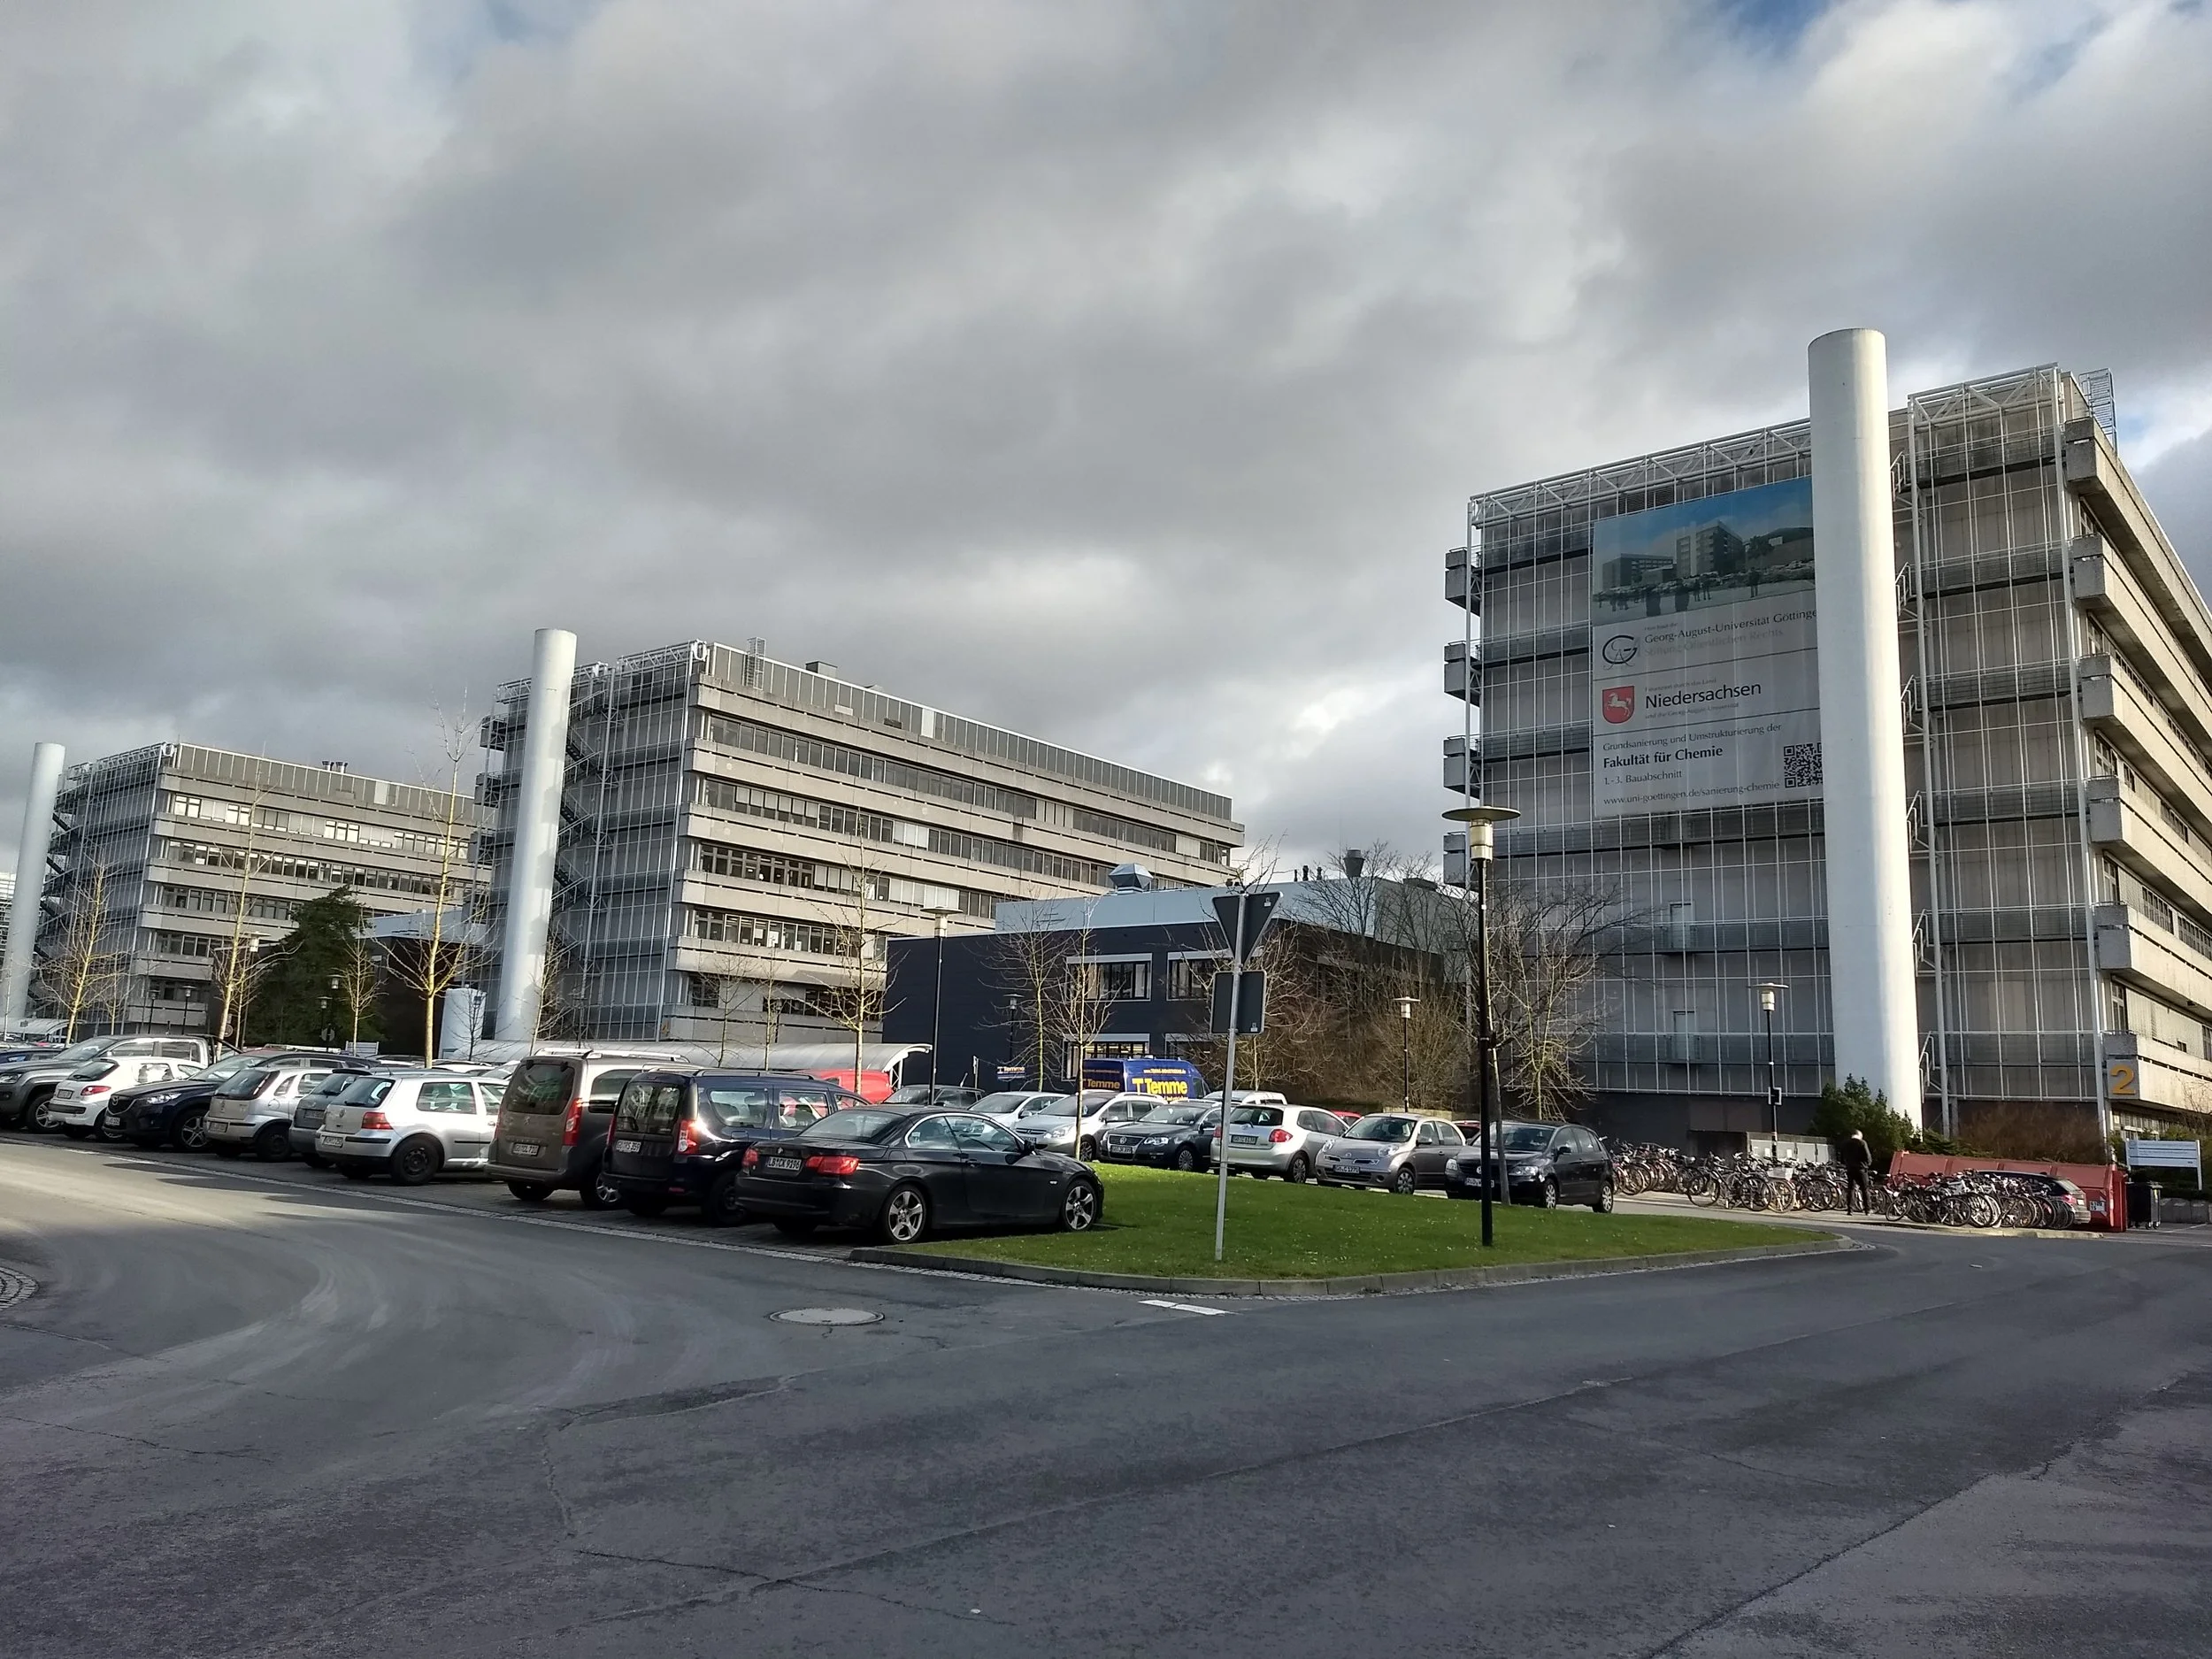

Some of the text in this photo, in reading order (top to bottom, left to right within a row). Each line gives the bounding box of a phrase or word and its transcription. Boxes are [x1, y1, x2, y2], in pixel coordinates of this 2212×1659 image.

[1645, 617, 1770, 643] Georg-August-Universität
[1646, 684, 1762, 709] Niedersachsen
[1602, 723, 1782, 751] Grundsanierung und Umstrukturierung der
[1603, 745, 1724, 768] Fakultät für Chemie
[1625, 771, 1683, 783] Bauabschnitt
[1603, 781, 1780, 804] www.uni-goettingen.de/sanierung-chemie
[1087, 1079, 1121, 1089] Temme
[1145, 1078, 1188, 1094] Temme
[2109, 1064, 2136, 1095] 2
[768, 1157, 776, 1167] LB
[786, 1159, 800, 1170] 9196
